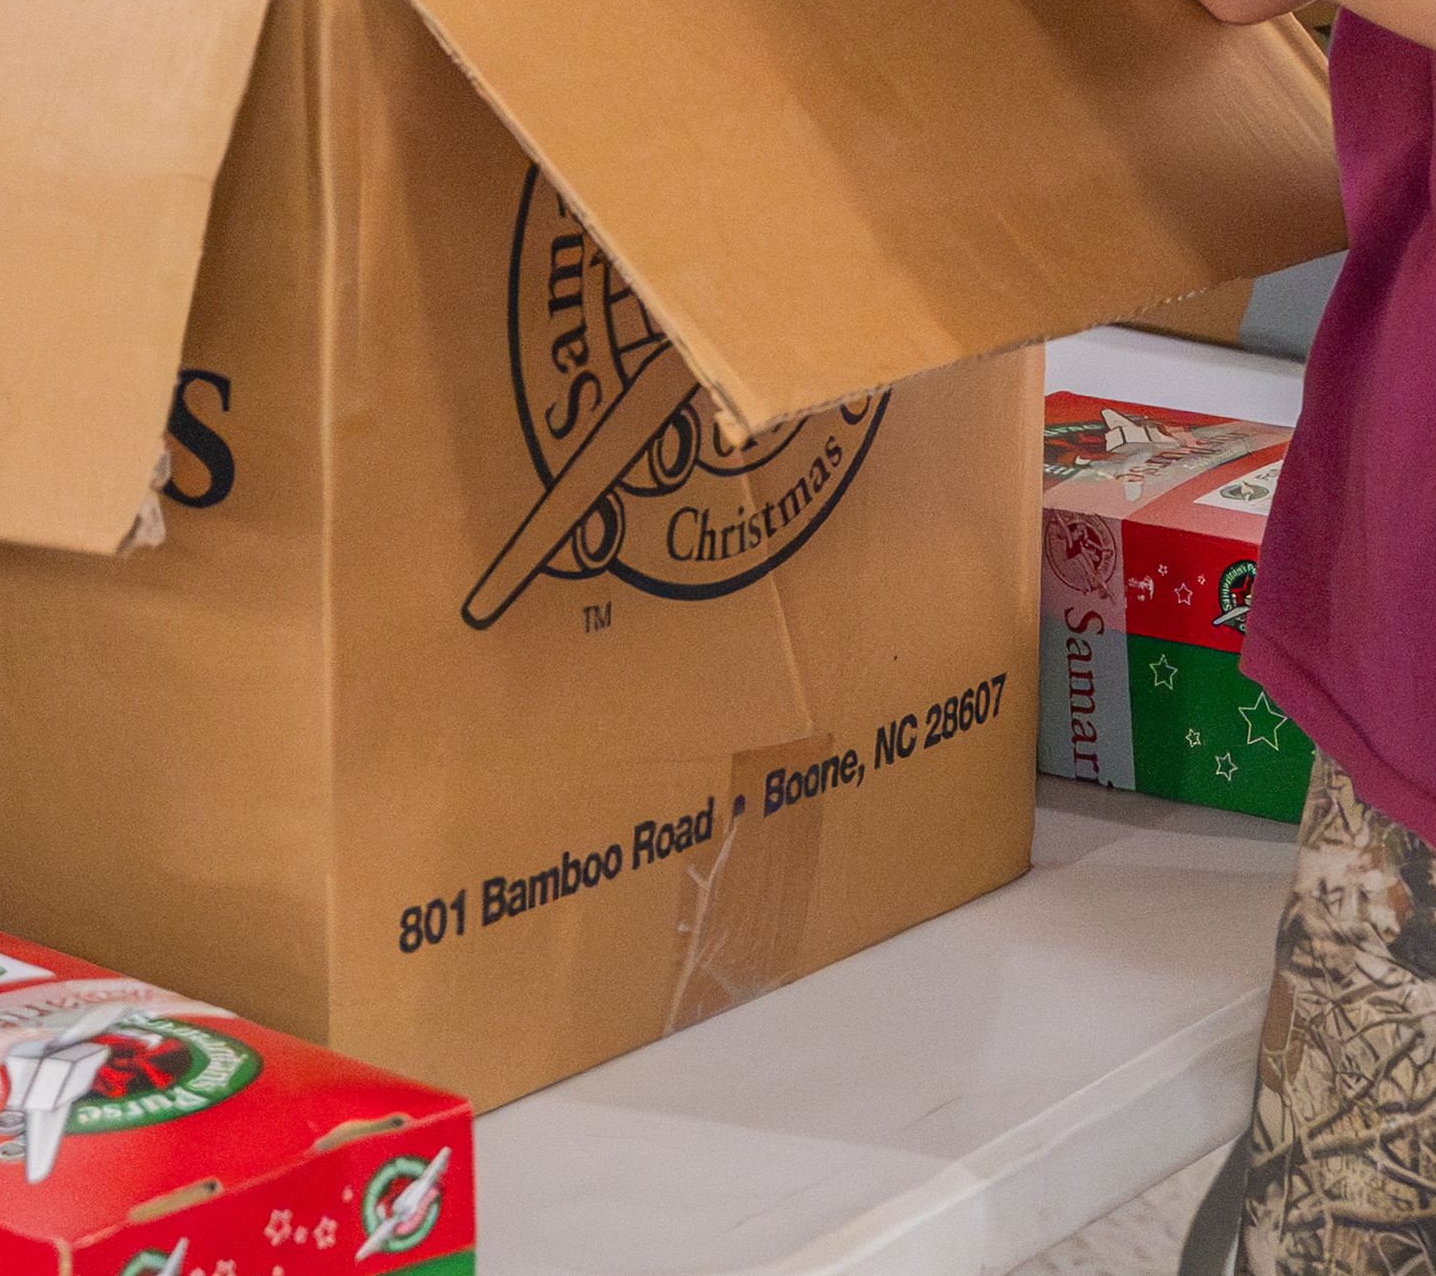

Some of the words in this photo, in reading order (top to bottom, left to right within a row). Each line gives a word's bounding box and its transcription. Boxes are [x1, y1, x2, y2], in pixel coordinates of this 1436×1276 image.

[545, 231, 602, 441] Sam
[667, 433, 844, 562] Christmas
[398, 889, 468, 954] 801
[481, 841, 624, 929] Bamboo
[631, 795, 715, 872] Road
[762, 747, 867, 819] Boone,
[873, 712, 919, 771] NC
[924, 671, 1008, 751] 28607
